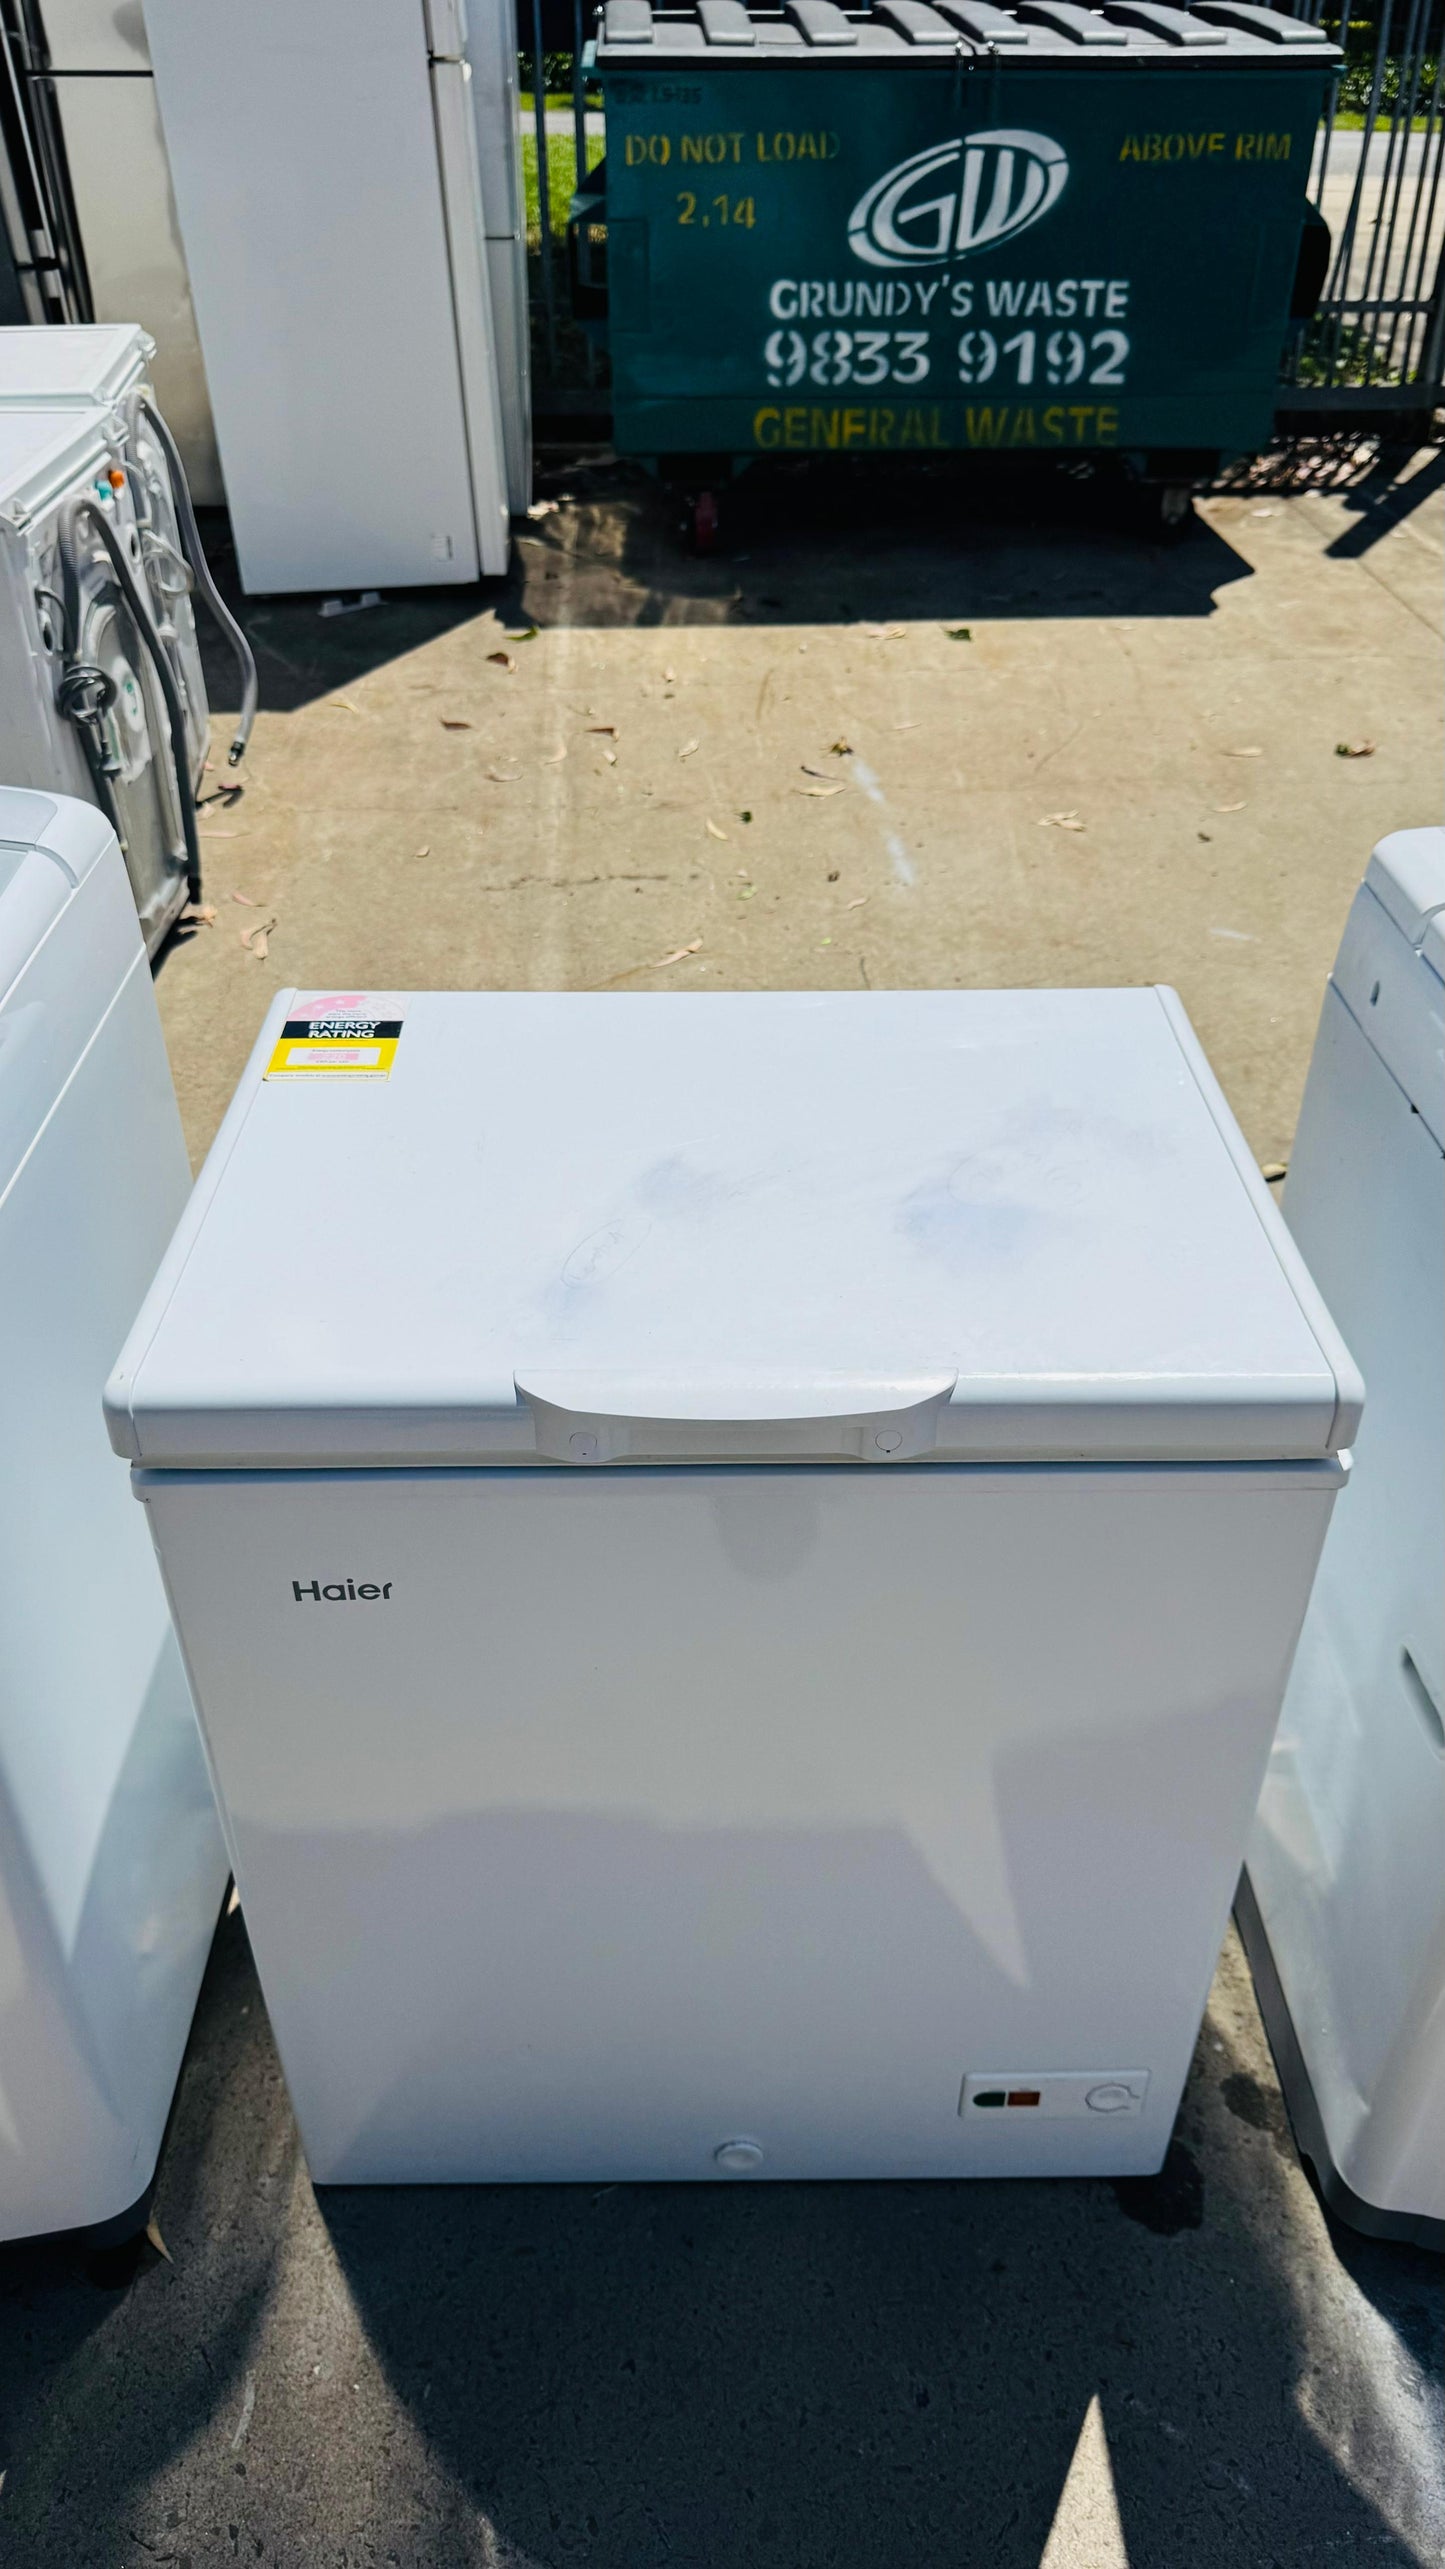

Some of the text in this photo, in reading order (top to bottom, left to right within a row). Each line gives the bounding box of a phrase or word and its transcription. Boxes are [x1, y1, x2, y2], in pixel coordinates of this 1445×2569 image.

[625, 130, 1292, 166] DO NOT LOAD ABOVE RIM
[769, 274, 1130, 320] GRUNDY'S WASTE
[764, 329, 1130, 388] 9833 9192
[752, 406, 1119, 449] GENERAL WASTE
[307, 1029, 376, 1039] RATING
[308, 1021, 381, 1030] ENERGY
[292, 1578, 393, 1602] Haier
